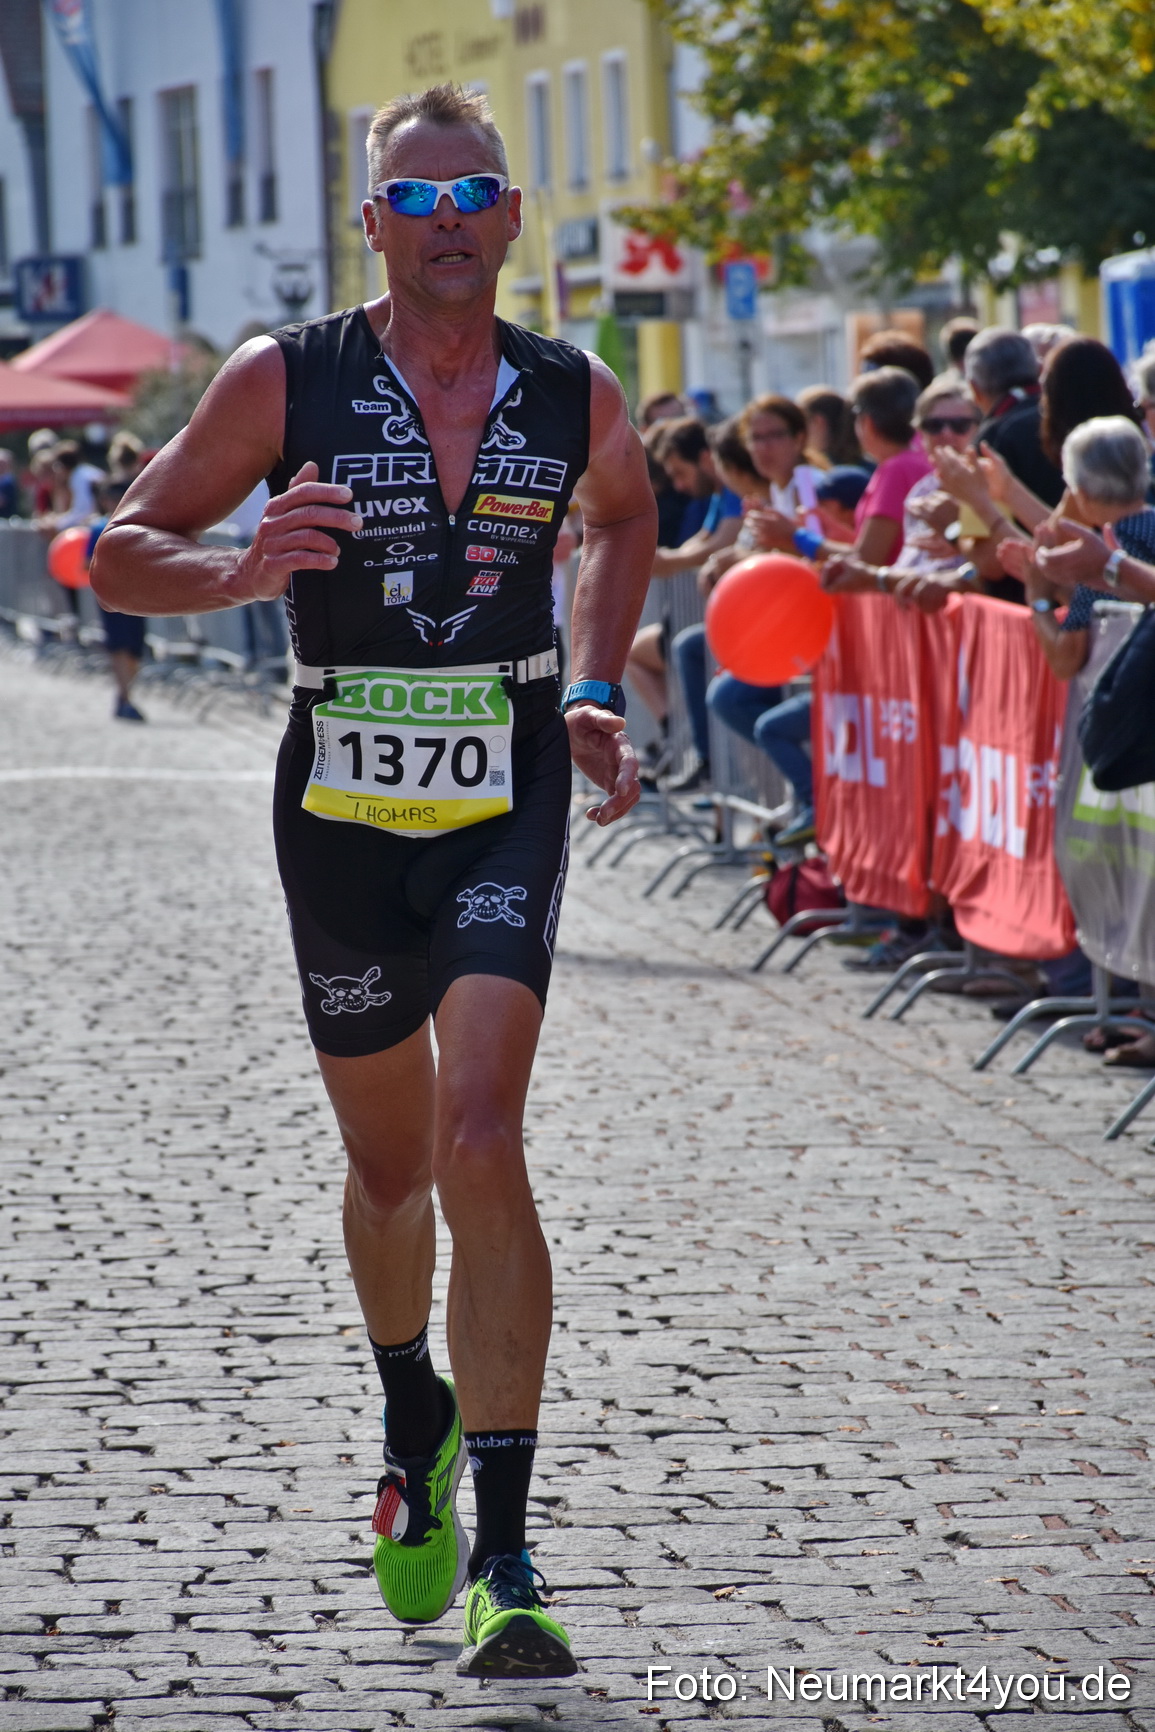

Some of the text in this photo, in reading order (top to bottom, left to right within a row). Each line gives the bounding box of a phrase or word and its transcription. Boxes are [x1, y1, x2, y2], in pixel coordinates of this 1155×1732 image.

[353, 401, 390, 412] Team
[354, 496, 430, 517] uvex
[327, 677, 496, 720] BOCK
[338, 731, 488, 788] 1370
[346, 794, 438, 824] THOMAS
